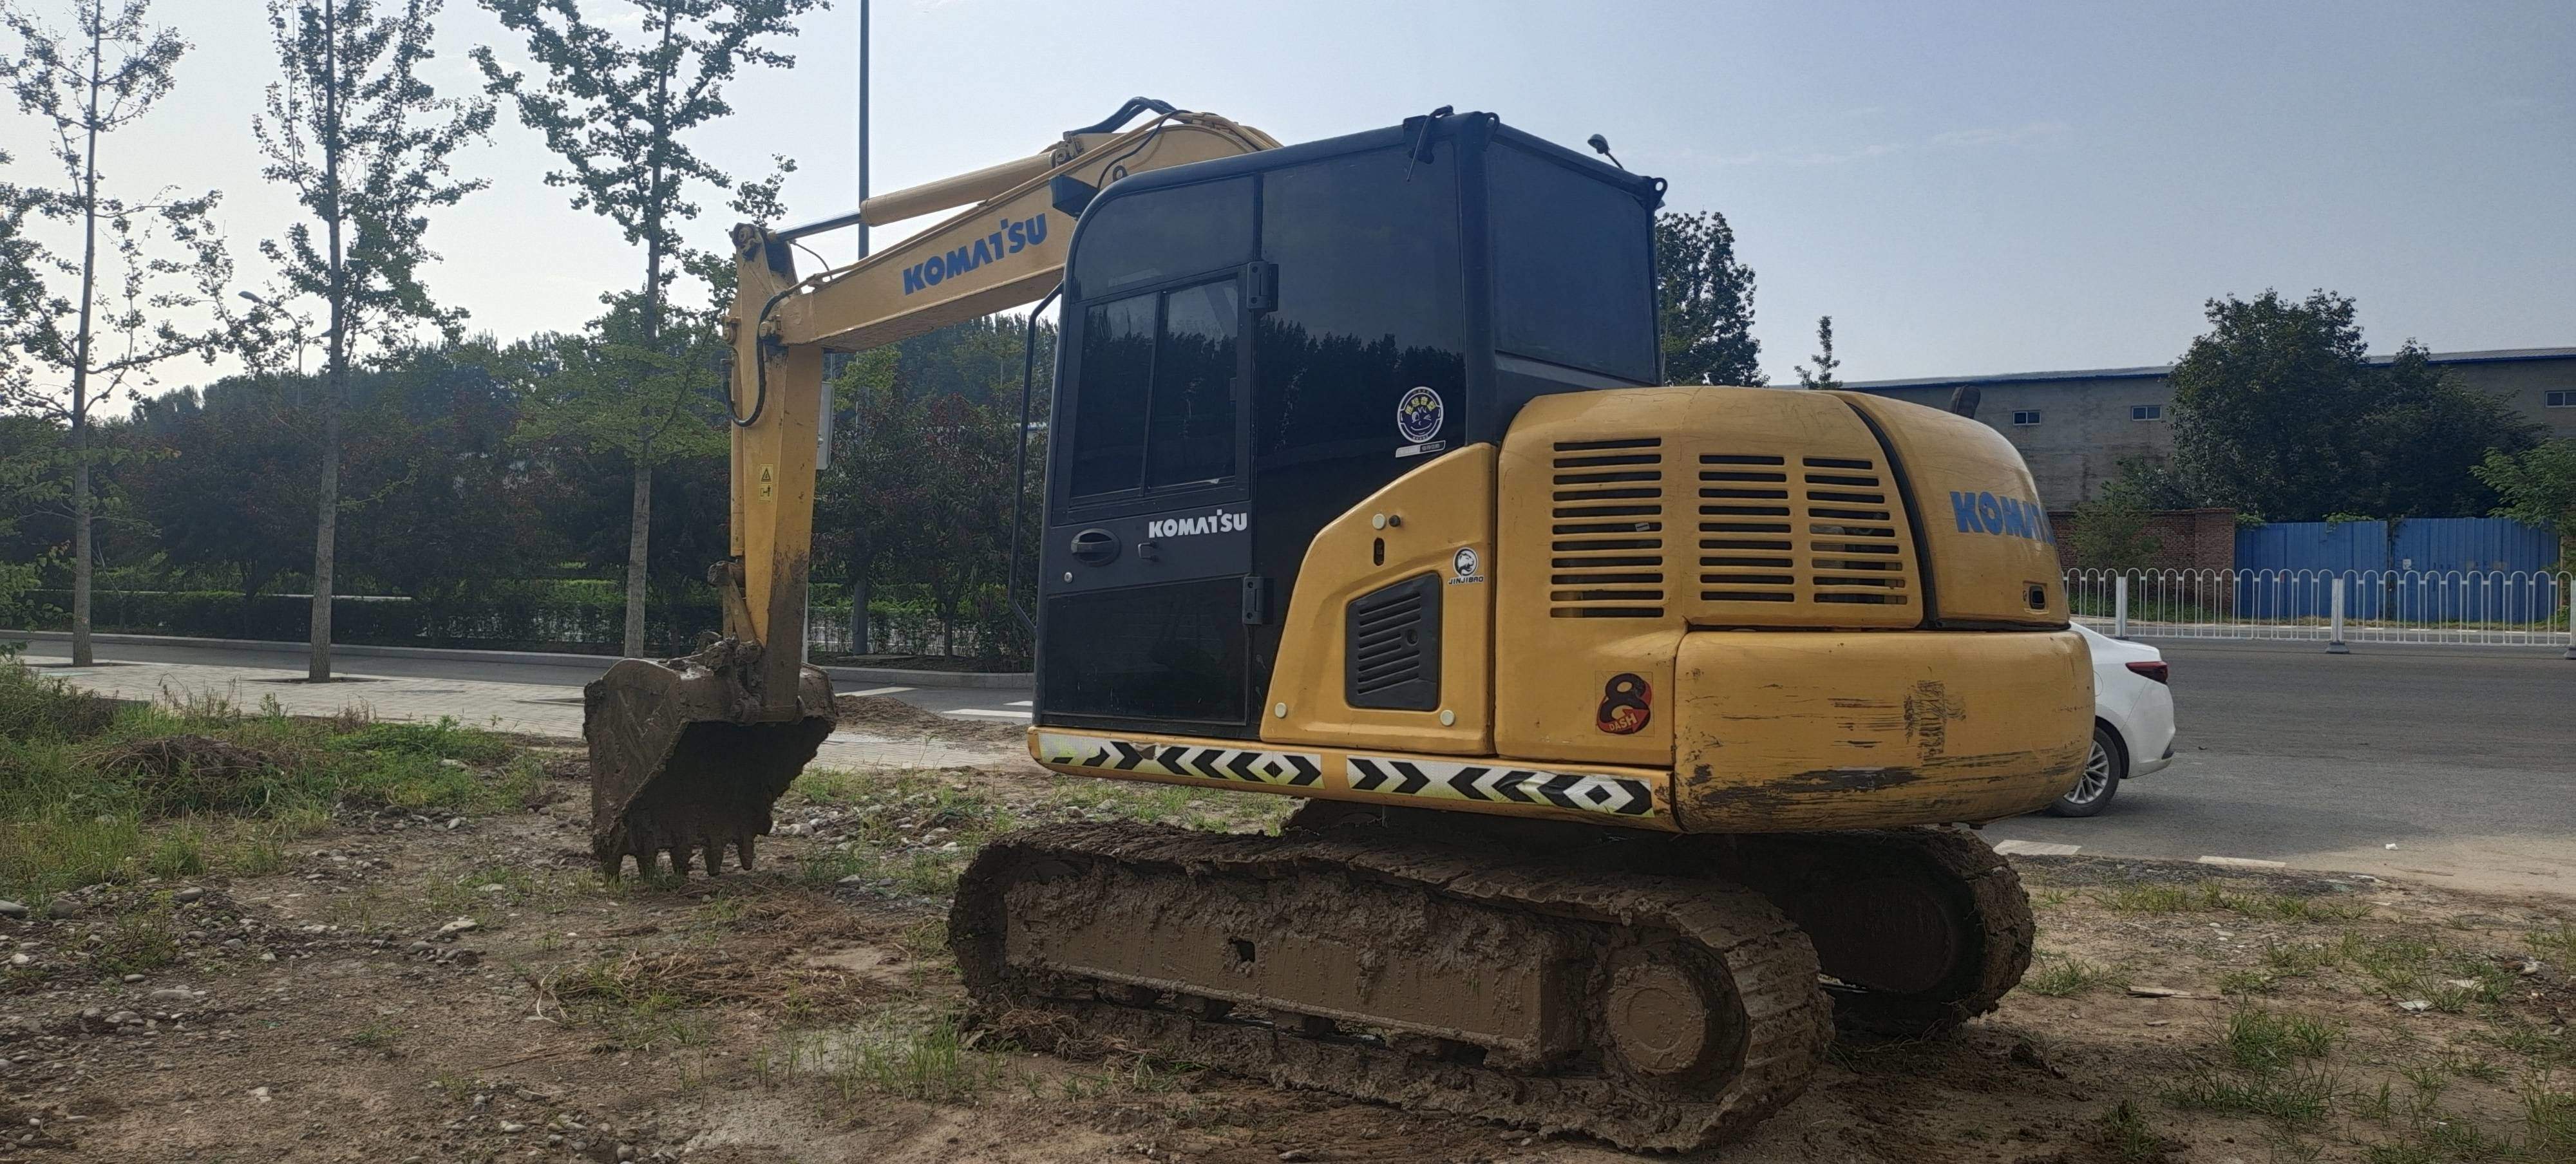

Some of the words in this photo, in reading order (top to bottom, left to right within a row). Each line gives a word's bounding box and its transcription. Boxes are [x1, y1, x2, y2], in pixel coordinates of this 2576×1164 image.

[903, 212, 1048, 296] KOMATSU
[1148, 509, 1247, 538] KOMATSU
[1448, 576, 1484, 585] JINJIBAO
[1598, 672, 1651, 735] 8
[1609, 712, 1638, 731] DASH
